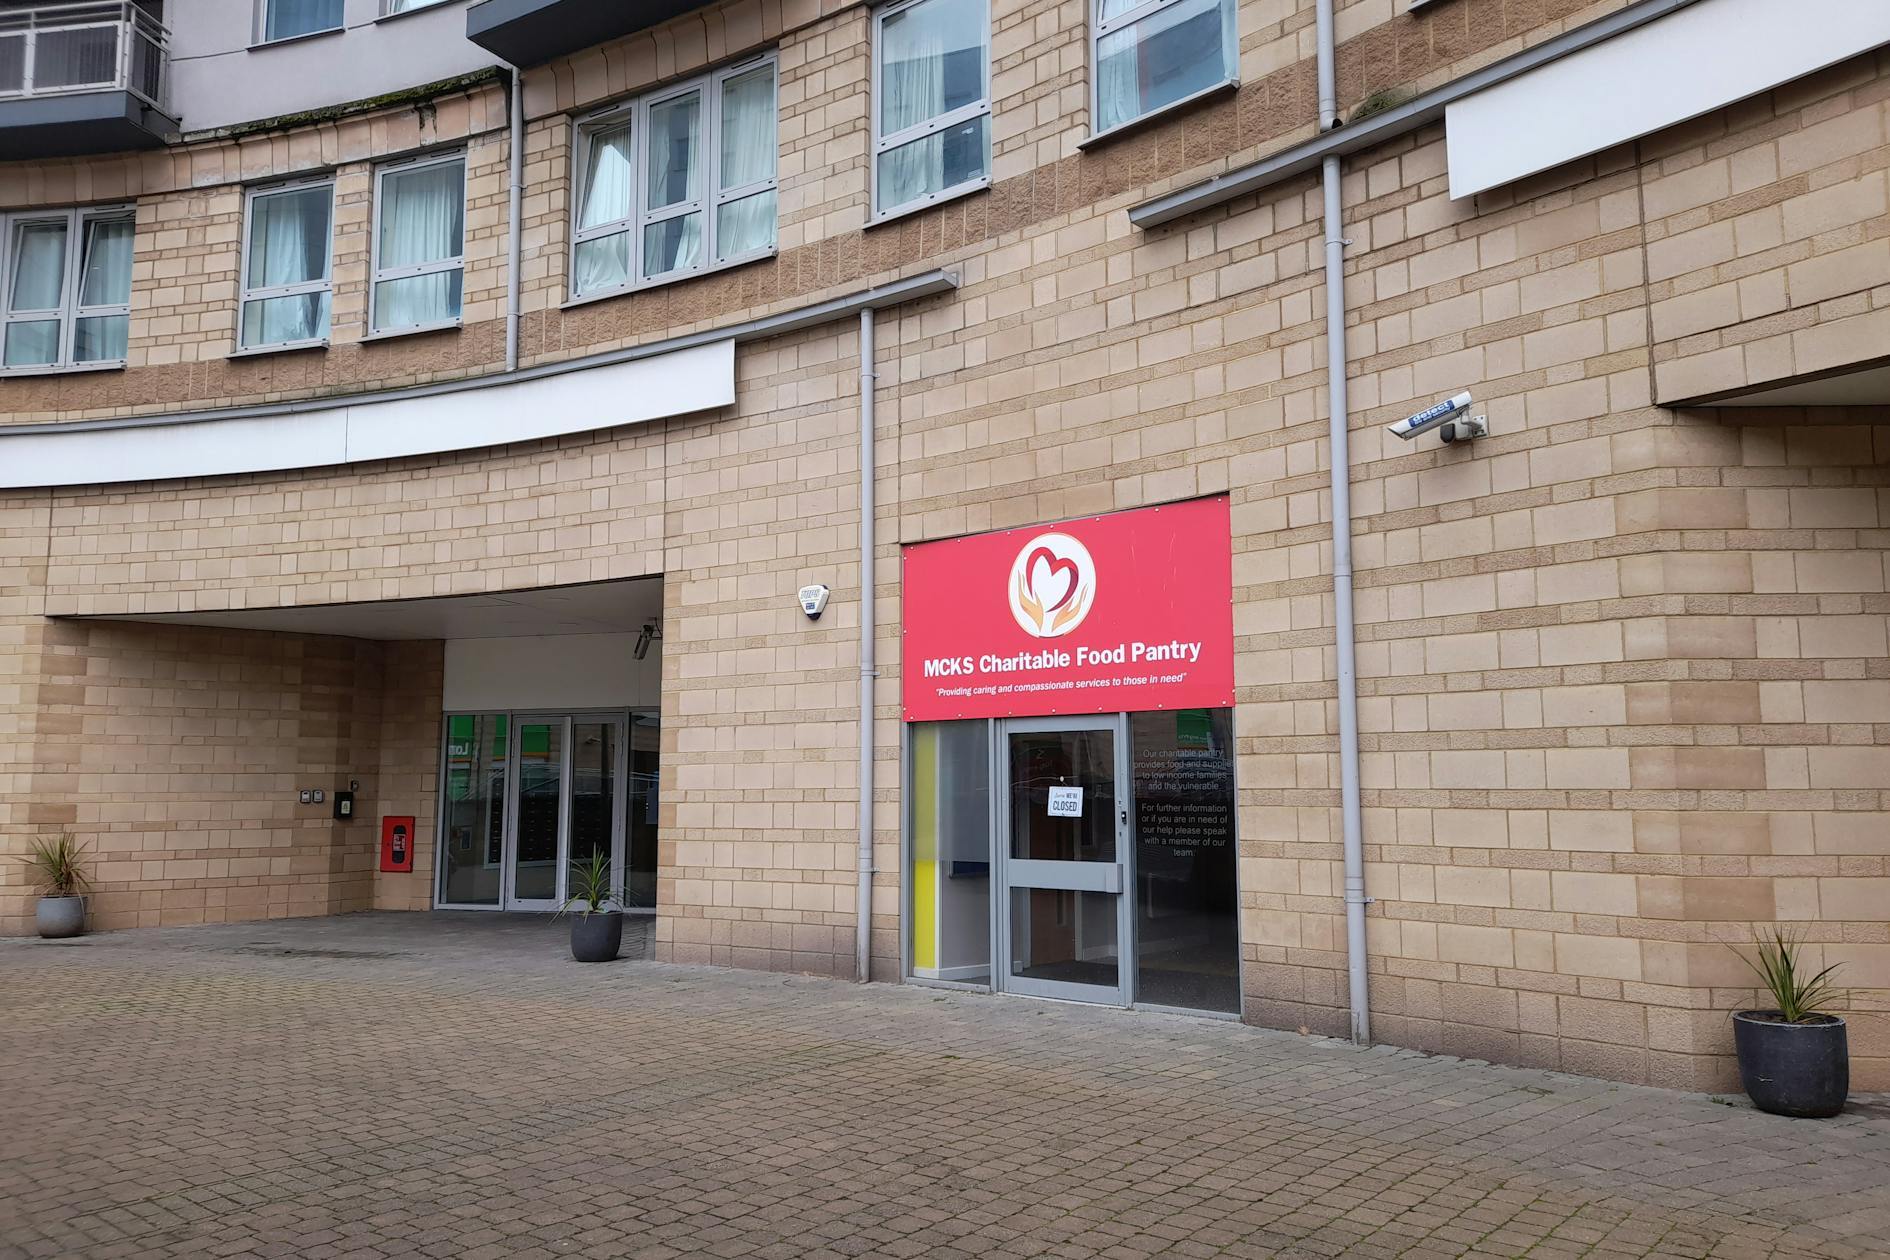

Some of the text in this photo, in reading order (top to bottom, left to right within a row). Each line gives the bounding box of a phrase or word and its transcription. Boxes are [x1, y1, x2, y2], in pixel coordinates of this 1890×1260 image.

[1413, 402, 1450, 421] detect
[924, 640, 1202, 677] MCKS Charitable Food Pantry
[936, 672, 1187, 697] "Providing caring and compassionate services to those in need"
[1143, 749, 1223, 760] Our charitable pantry
[1148, 782, 1162, 790] and
[1164, 782, 1177, 790] the
[1053, 801, 1077, 811] CLOSED
[1142, 803, 1227, 812] For further information
[1158, 816, 1172, 824] you
[1198, 816, 1218, 824] need
[1220, 816, 1228, 824] of
[1156, 826, 1173, 835] help
[1175, 826, 1201, 836] please
[1202, 827, 1226, 836] speak
[1144, 836, 1160, 845] with
[1168, 838, 1200, 846] member
[1202, 838, 1210, 846] of
